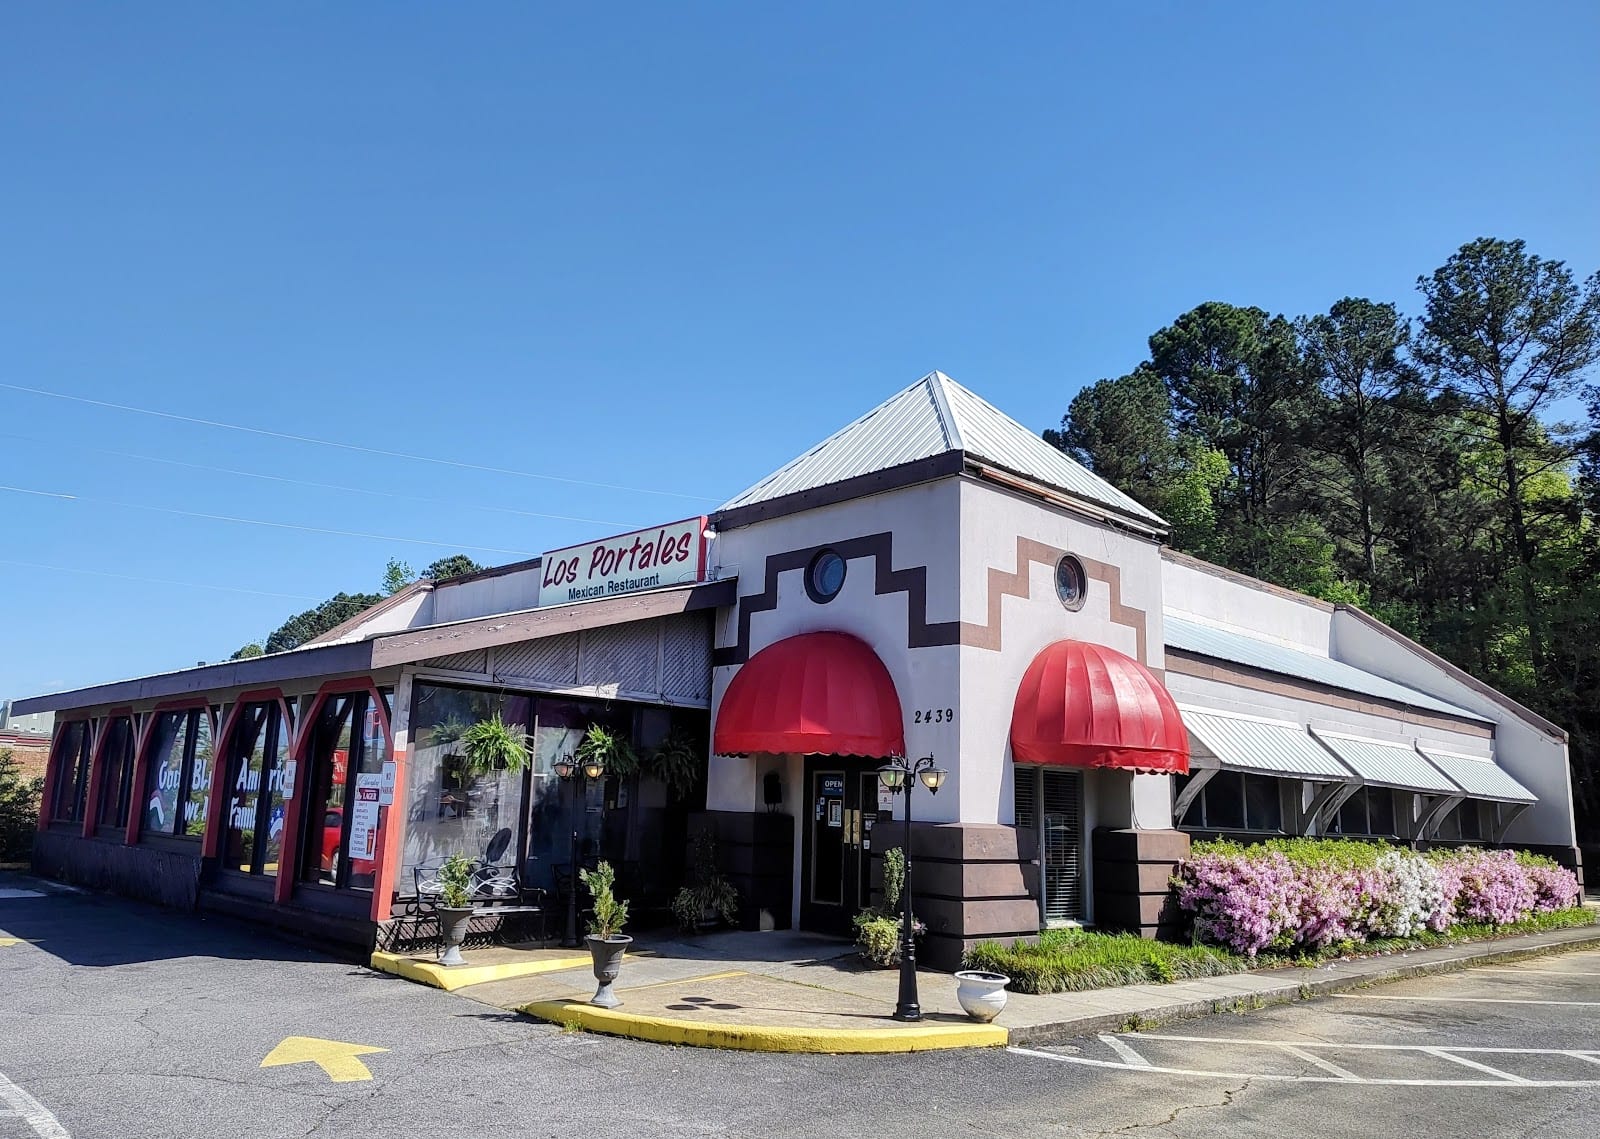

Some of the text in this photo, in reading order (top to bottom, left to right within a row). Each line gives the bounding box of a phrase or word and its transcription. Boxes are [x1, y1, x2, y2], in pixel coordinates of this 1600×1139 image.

[543, 530, 692, 588] Los Portales
[568, 572, 660, 600] Mexican Restaurant
[914, 708, 953, 724] 2439
[824, 780, 843, 788] OPEN
